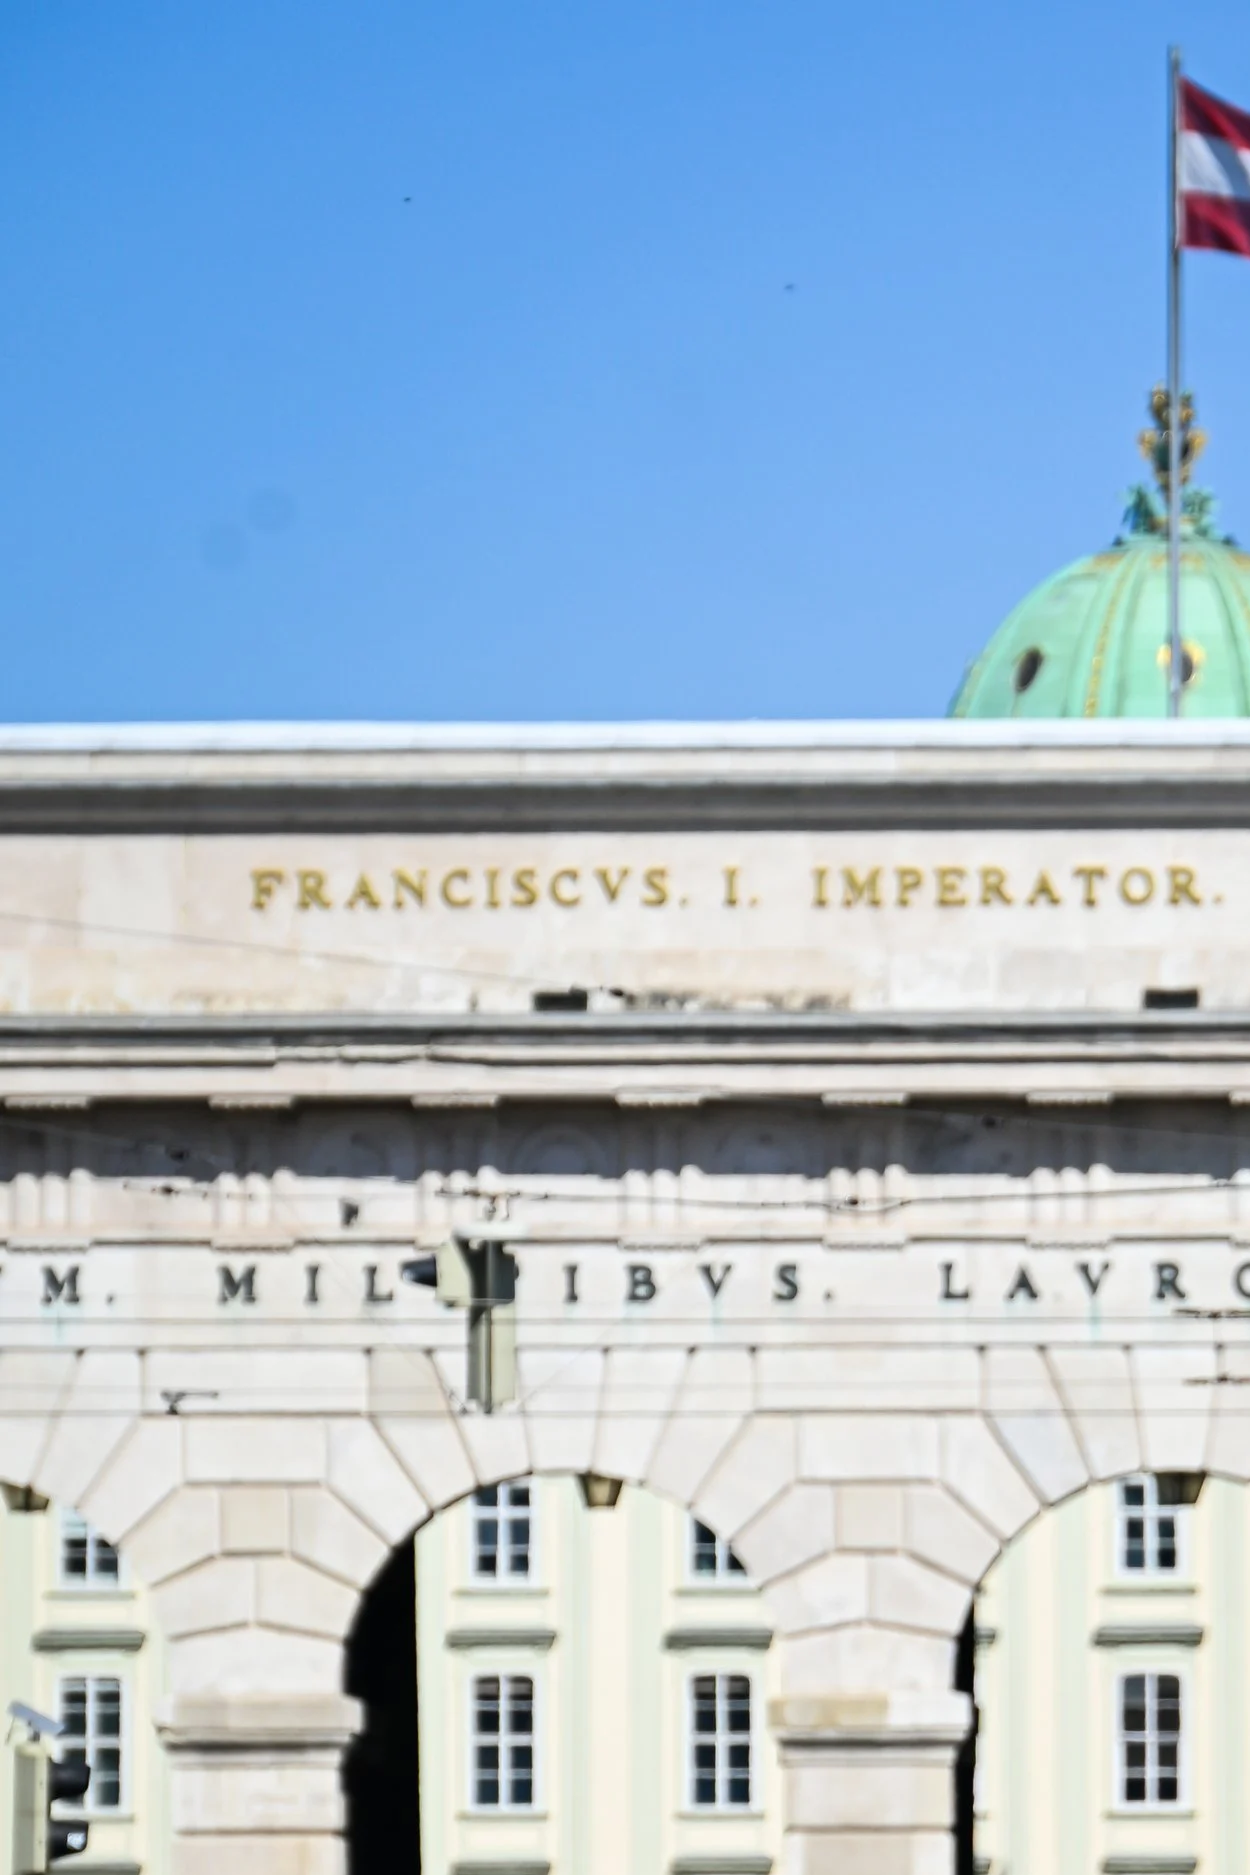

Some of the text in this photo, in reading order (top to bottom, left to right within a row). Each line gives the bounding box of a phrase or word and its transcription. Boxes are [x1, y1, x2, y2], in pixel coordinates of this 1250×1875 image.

[250, 868, 687, 909] FRANCISCVS.
[723, 868, 758, 907] I.
[812, 866, 1222, 908] IMPERATOR.
[0, 1264, 115, 1305] M.
[217, 1262, 833, 1305] MILIBVS.
